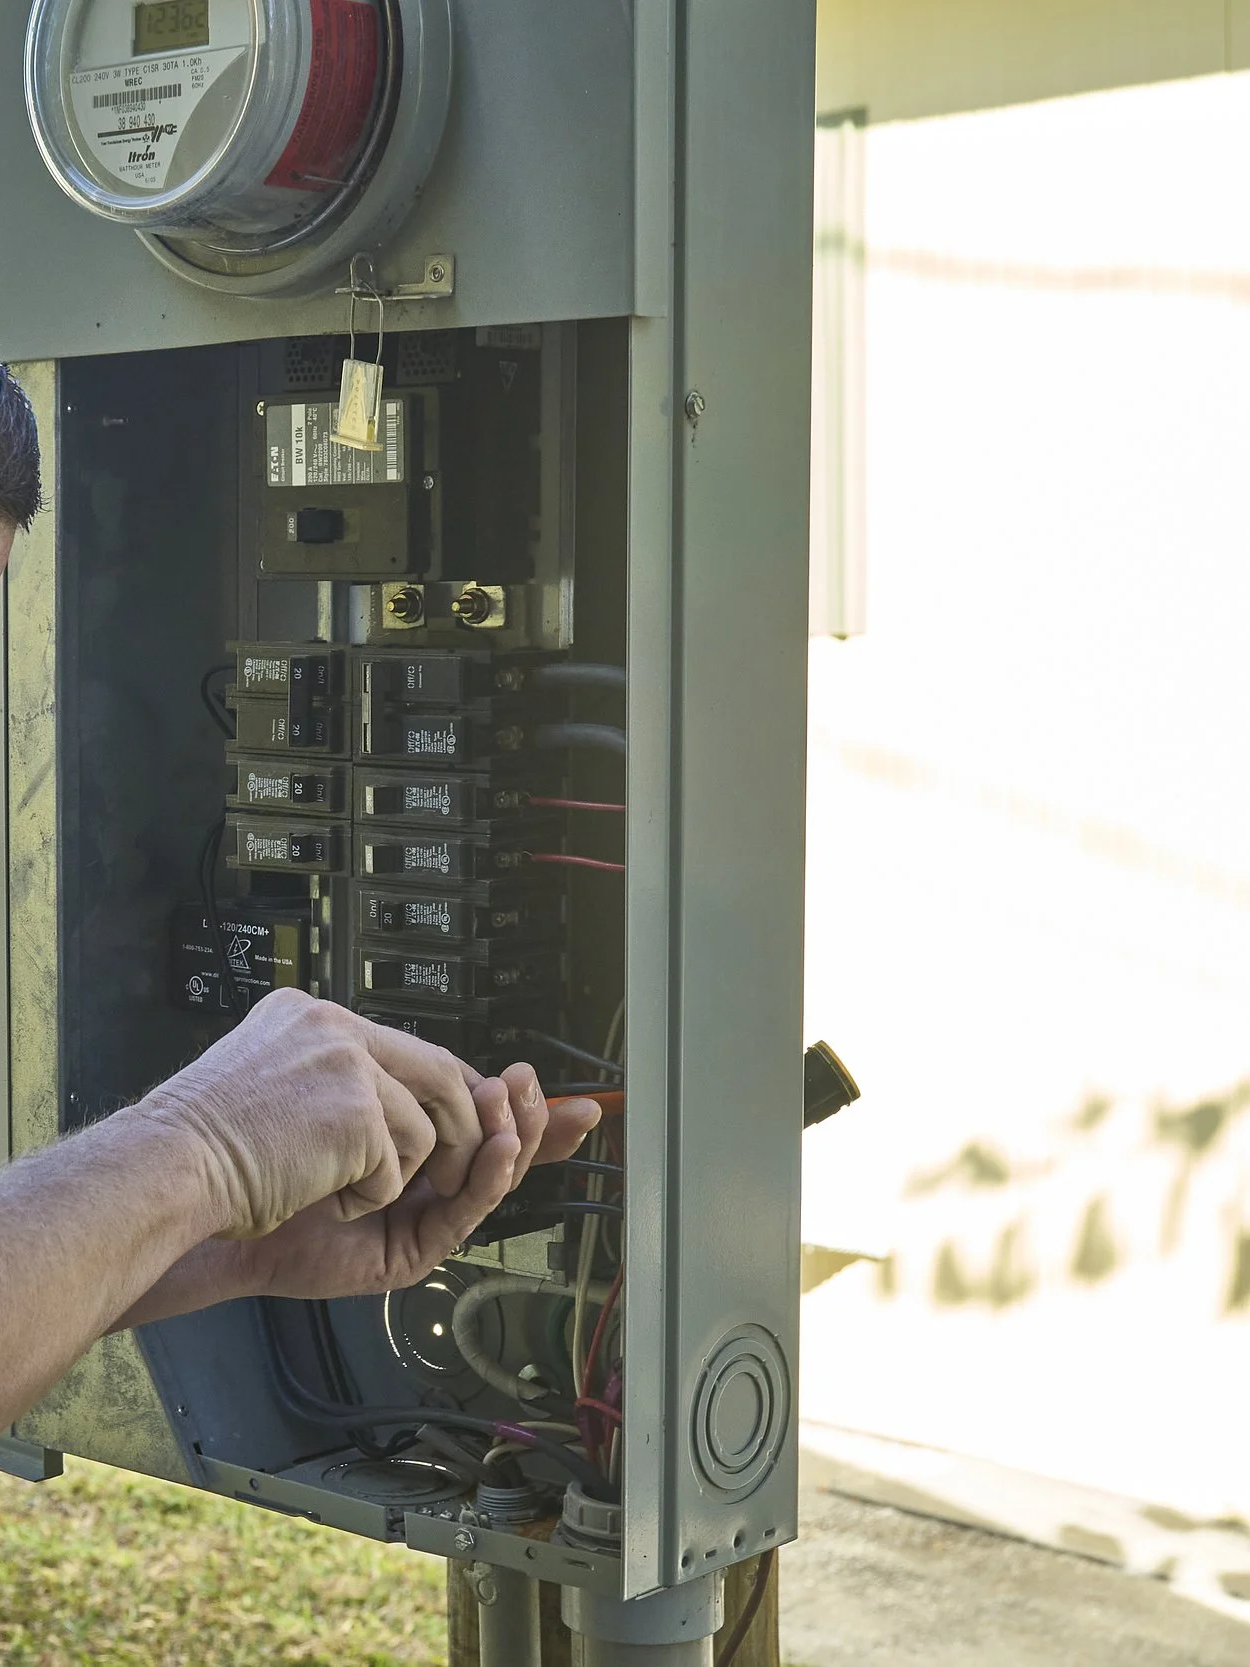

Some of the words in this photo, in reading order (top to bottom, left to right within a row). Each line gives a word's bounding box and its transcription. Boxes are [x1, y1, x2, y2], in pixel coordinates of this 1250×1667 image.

[71, 73, 91, 85] CL200
[94, 72, 110, 82] 240V
[112, 70, 122, 79] 3W
[124, 67, 140, 77] TYPE
[162, 60, 179, 72] 30TA
[124, 77, 143, 87] WREC
[117, 116, 126, 130] 38
[128, 114, 141, 128] 940
[143, 112, 156, 127] 430
[128, 145, 156, 163] Itron
[145, 161, 161, 169] METER
[134, 171, 145, 179] USA
[295, 426, 303, 444] 10k
[270, 446, 279, 482] EATON
[295, 448, 303, 464] BW
[280, 660, 288, 682] Off/O
[293, 667, 302, 680] 20
[317, 665, 325, 684] On/I
[407, 665, 415, 689] Off/O
[277, 718, 286, 741] Off/O
[292, 724, 300, 736] 20
[407, 730, 415, 754] Off/O
[281, 776, 289, 798] Off/O
[294, 782, 303, 795] 20
[405, 786, 413, 808] Off/O
[292, 845, 300, 857] 20
[315, 843, 323, 861] On/I
[404, 846, 412, 869] Off/O
[369, 899, 377, 918] On/I
[384, 912, 393, 924] 20
[254, 954, 268, 962] Made
[404, 963, 412, 985] Off/O
